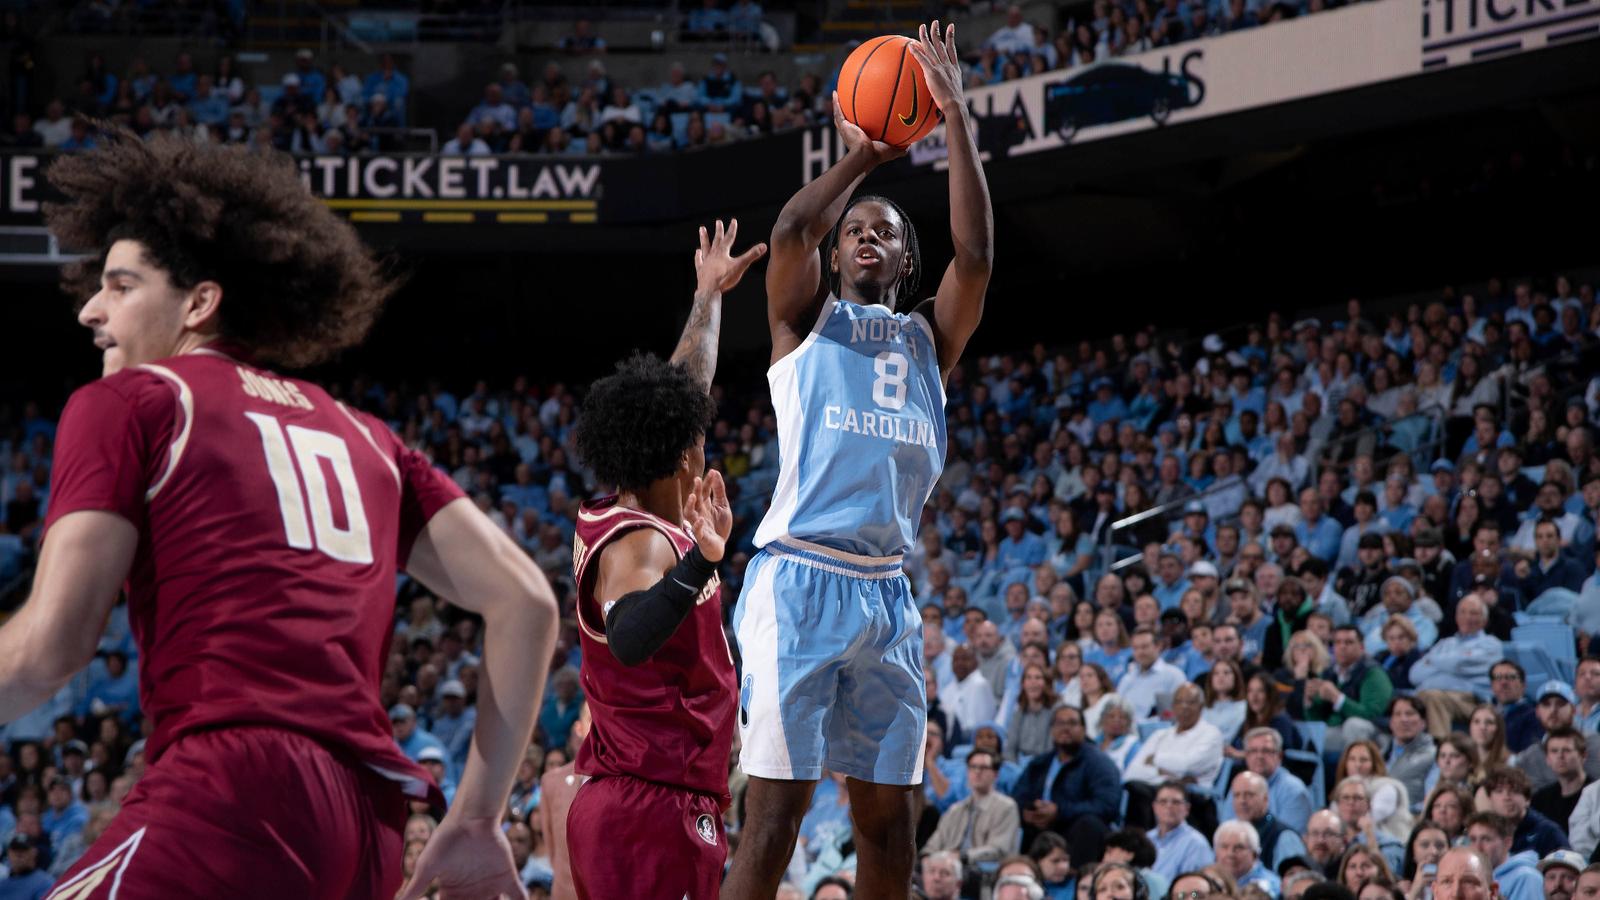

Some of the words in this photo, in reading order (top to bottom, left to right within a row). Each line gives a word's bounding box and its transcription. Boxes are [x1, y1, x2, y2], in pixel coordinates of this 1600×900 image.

[301, 156, 600, 198] iTICKET.LAW
[872, 351, 909, 410] 8
[243, 411, 374, 564] 10
